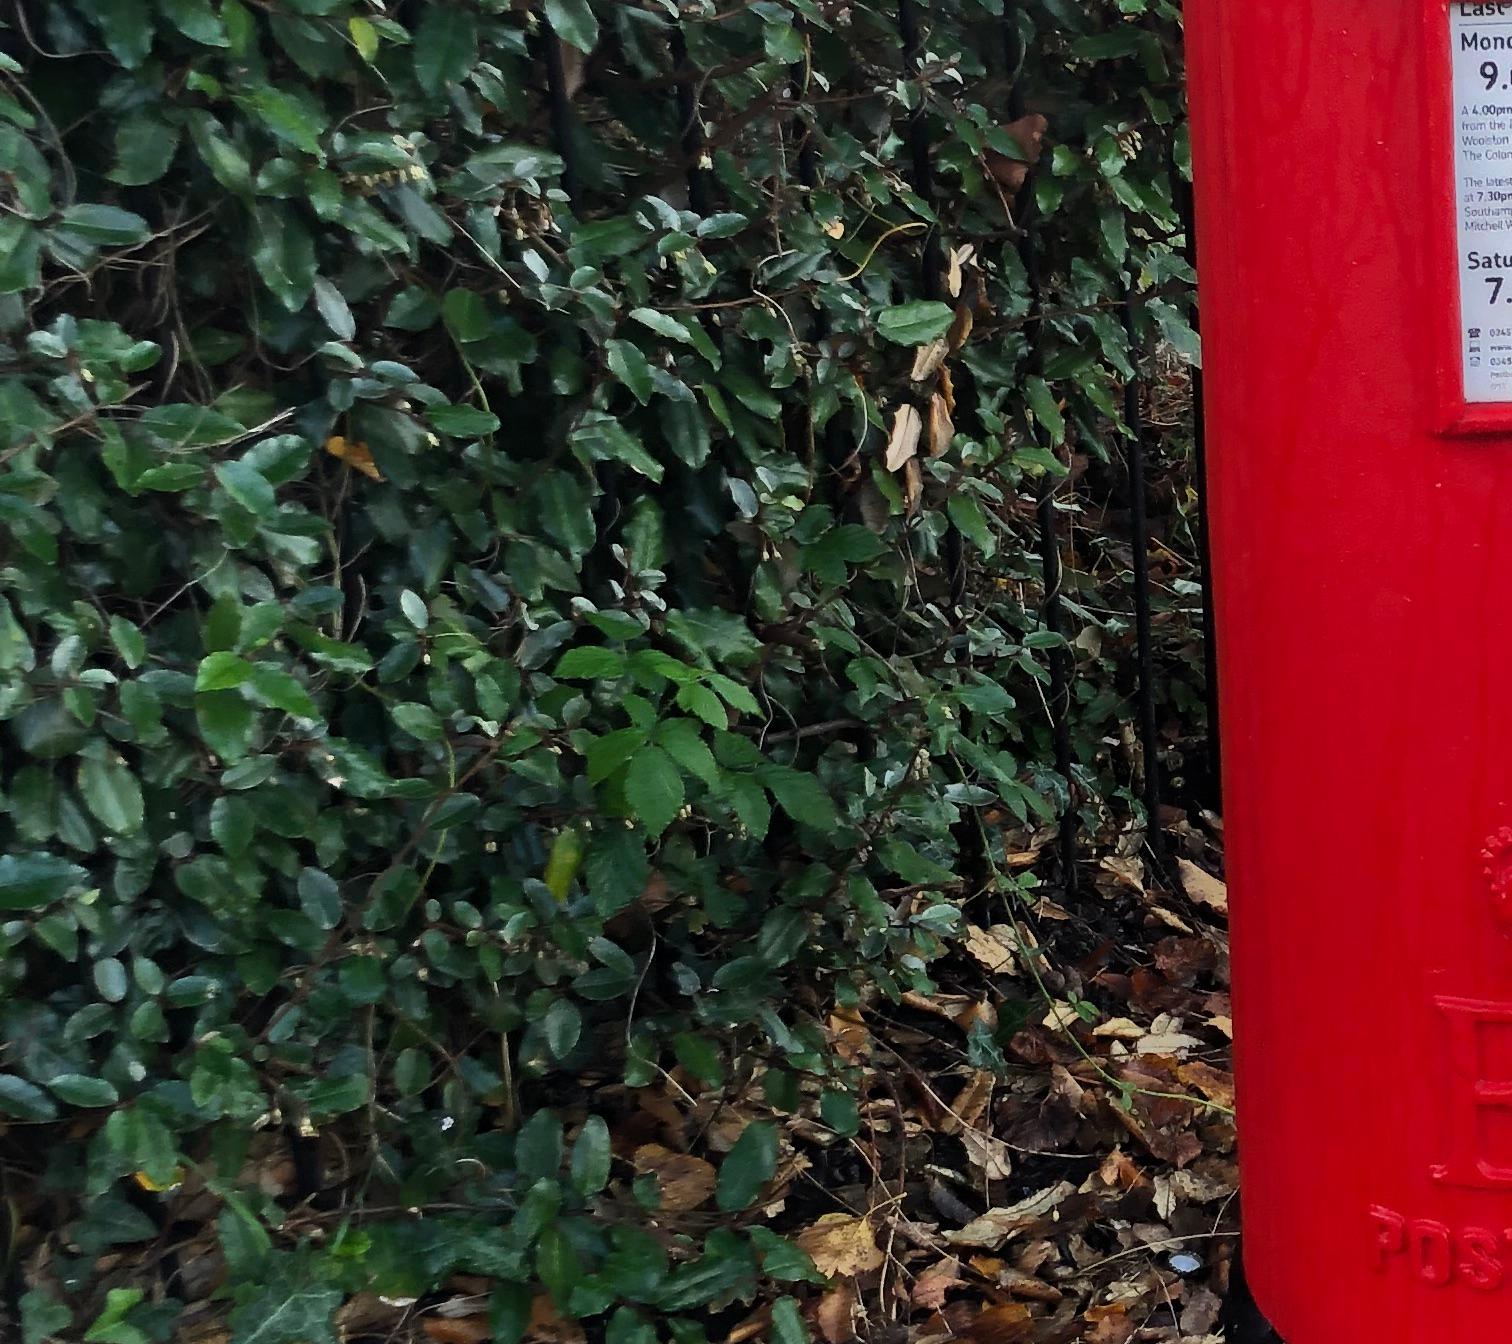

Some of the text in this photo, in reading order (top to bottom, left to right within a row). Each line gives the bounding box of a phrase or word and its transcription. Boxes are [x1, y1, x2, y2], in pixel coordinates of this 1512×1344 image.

[1460, 1, 1505, 17] Last
[1472, 104, 1512, 116] 4.00pm
[1462, 120, 1486, 131] from
[1489, 119, 1506, 130] the
[1462, 149, 1482, 161] The
[1463, 176, 1483, 187] The
